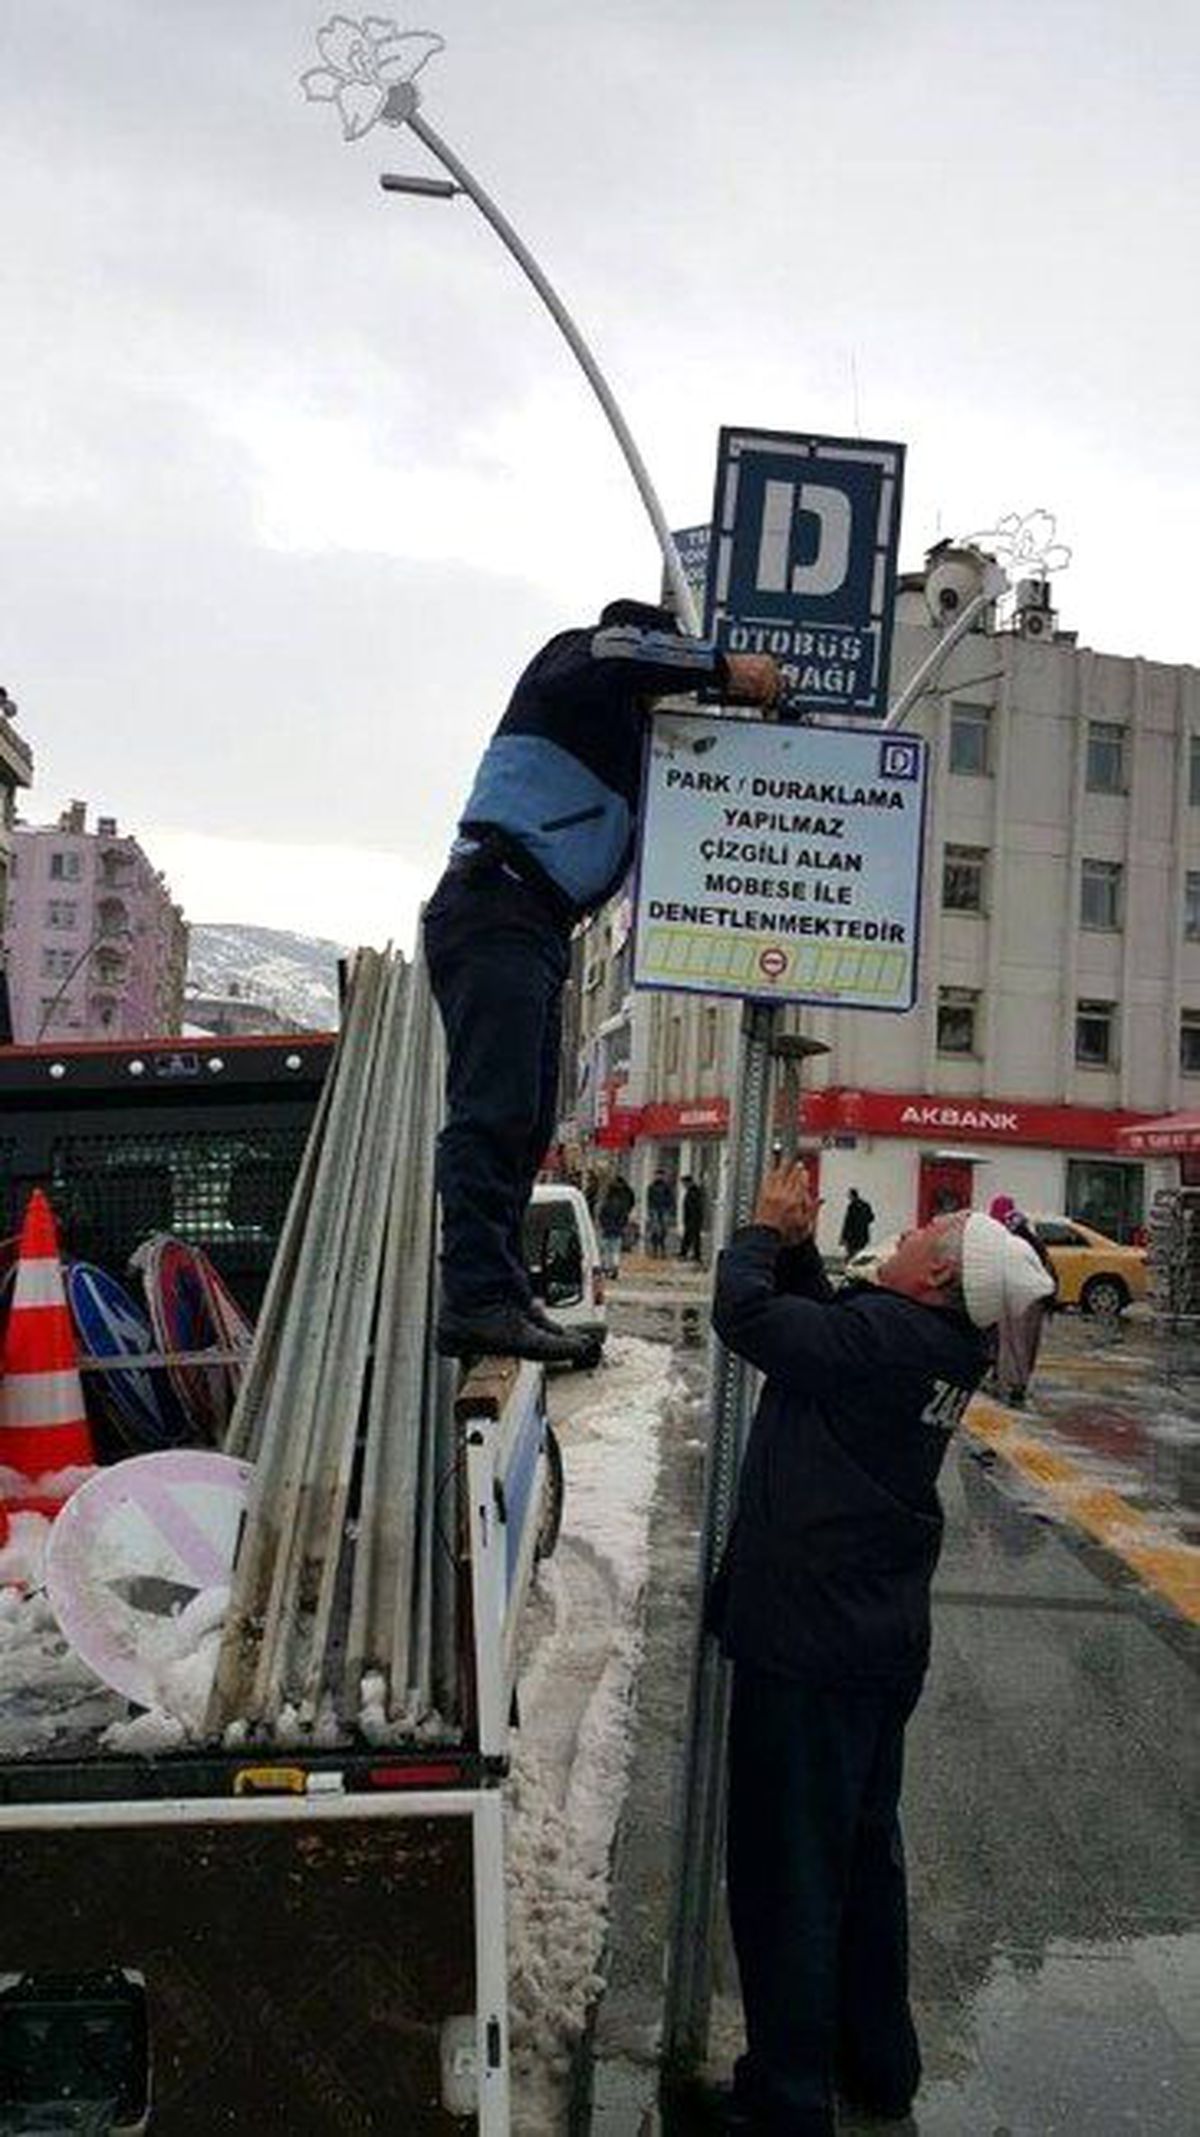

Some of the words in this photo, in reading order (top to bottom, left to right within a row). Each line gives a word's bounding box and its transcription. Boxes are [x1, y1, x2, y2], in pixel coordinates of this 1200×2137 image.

[755, 479, 851, 596] D
[729, 627, 862, 661] OTOBÜS
[779, 662, 857, 694] RAĞI
[889, 748, 911, 771] D
[666, 769, 730, 793] PARK
[738, 778, 745, 793] /
[752, 778, 905, 809] DURAKLAMA
[724, 809, 845, 838] YAPILMAZ
[700, 839, 788, 866] ÇİZGİLİ
[796, 850, 863, 872] ALAN
[705, 874, 806, 901] MOBESE
[814, 881, 852, 905] İLE
[649, 902, 905, 943] DENETLENMEKTEDİR
[900, 1106, 1018, 1130] AKBANK
